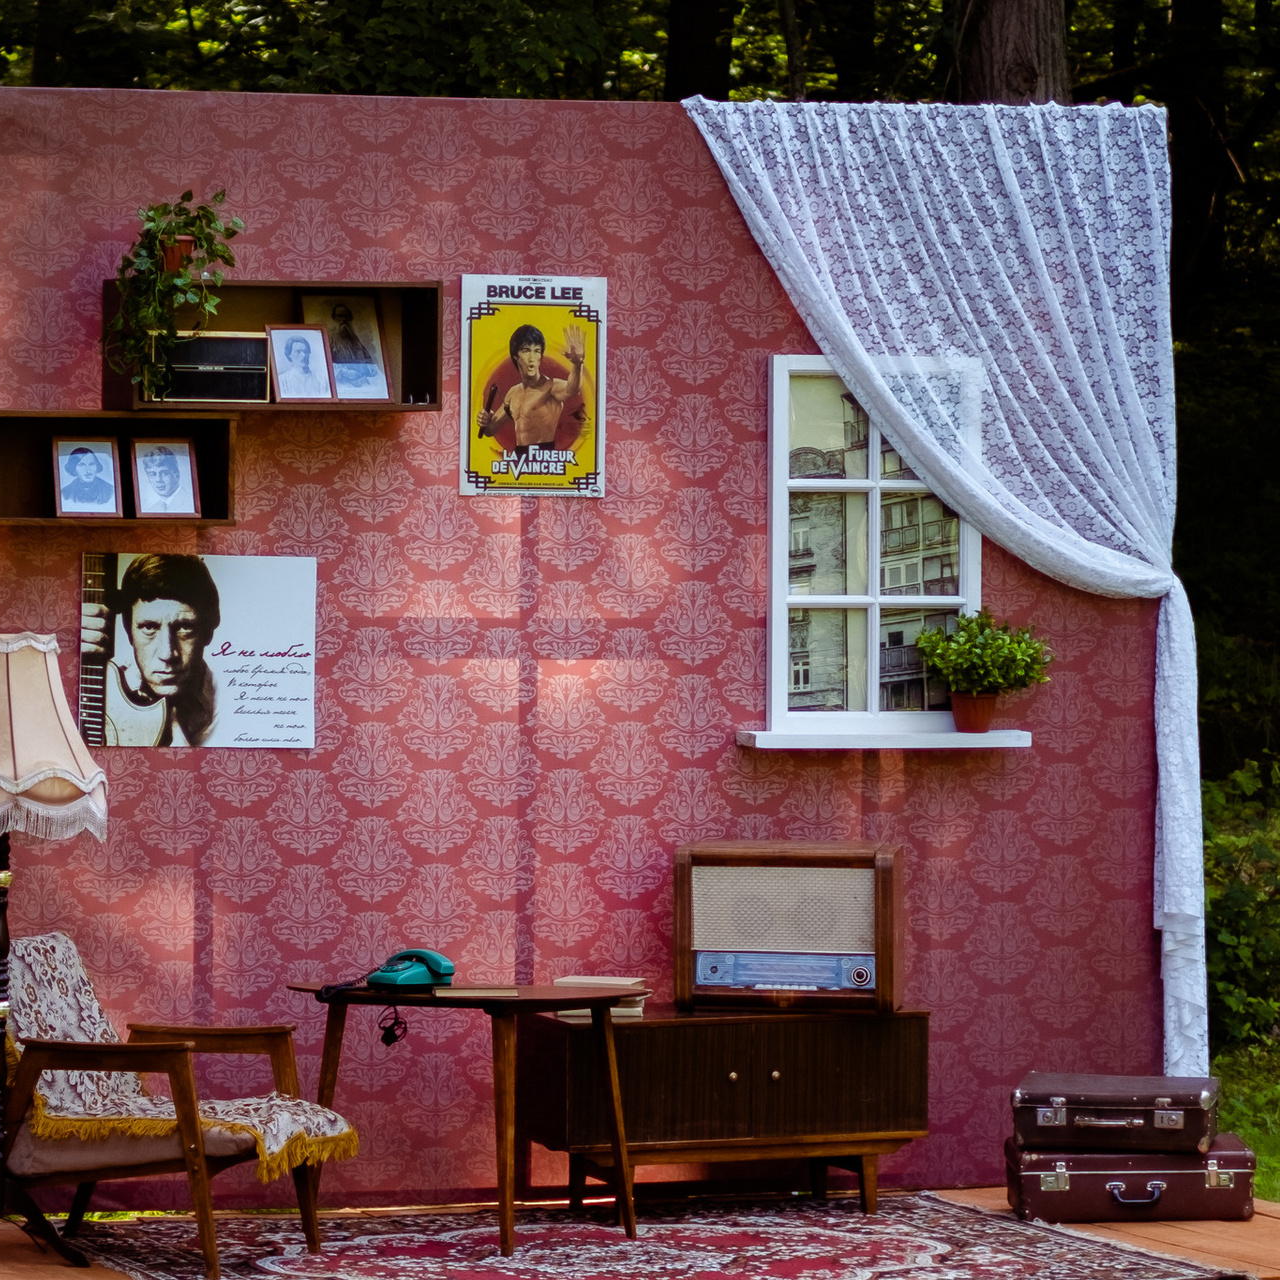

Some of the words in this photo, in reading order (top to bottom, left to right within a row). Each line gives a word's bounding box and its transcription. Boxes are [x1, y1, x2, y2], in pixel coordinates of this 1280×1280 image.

[486, 285, 546, 300] BRUCE
[550, 286, 583, 300] LEE
[503, 449, 518, 461] LA
[528, 445, 577, 465] FUREUR
[491, 461, 508, 473] DE
[509, 454, 565, 480] VAINCRE
[211, 641, 236, 657] Я
[238, 649, 256, 657] не
[259, 643, 312, 658] люблю
